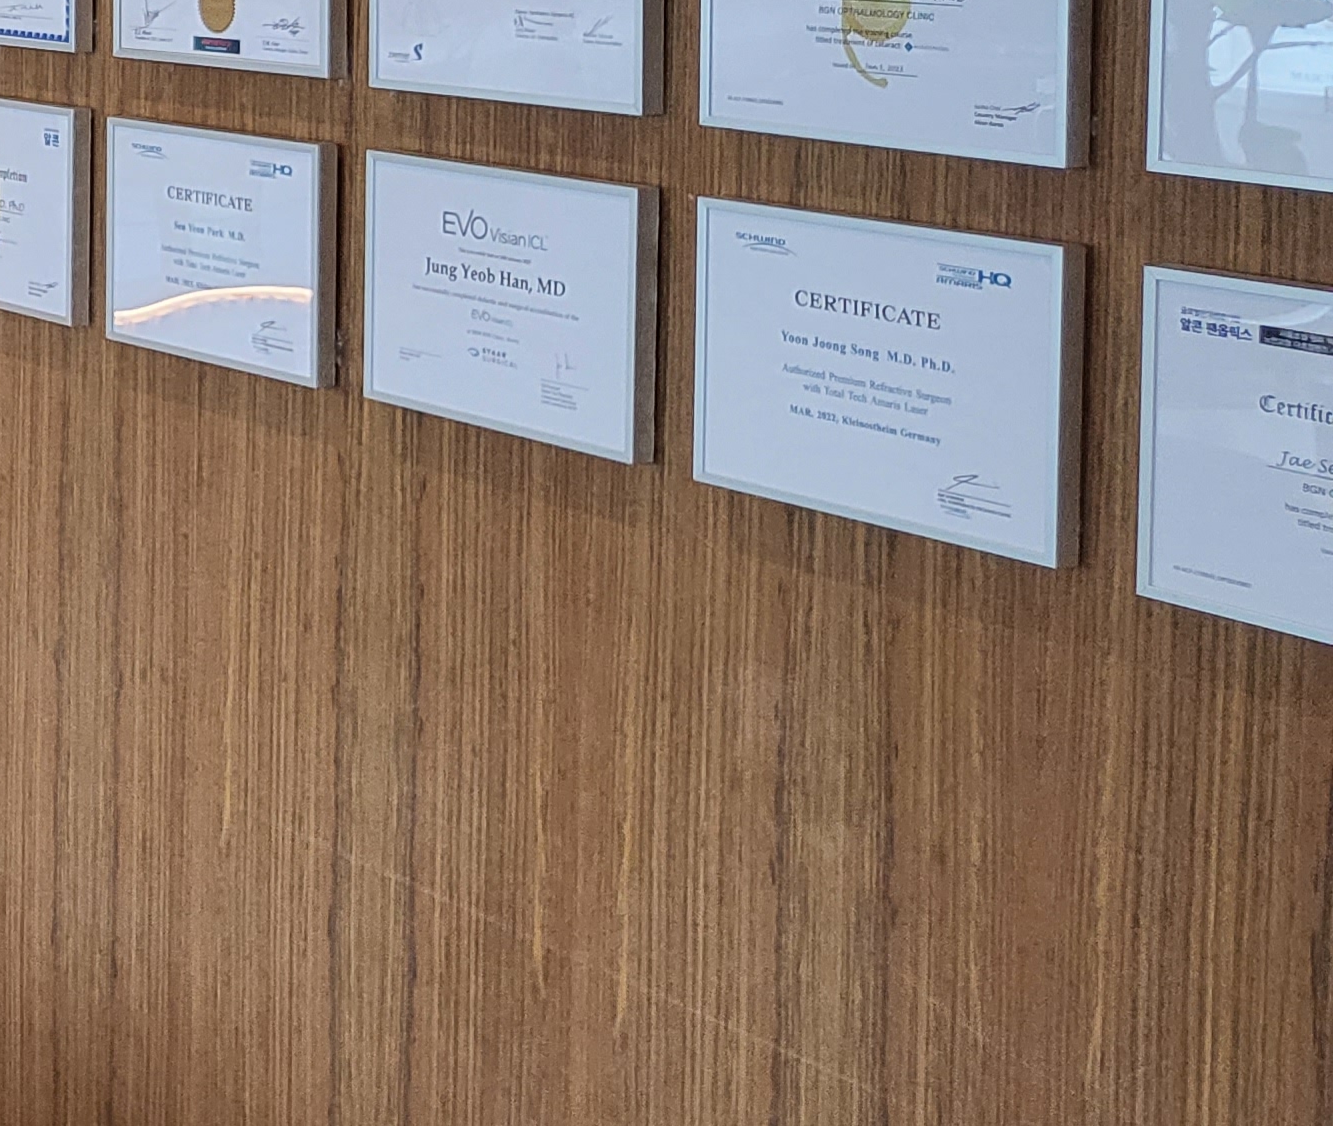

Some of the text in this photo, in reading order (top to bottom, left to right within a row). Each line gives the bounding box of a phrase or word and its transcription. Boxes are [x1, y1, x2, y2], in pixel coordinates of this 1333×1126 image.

[907, 11, 935, 21] CLINIC
[272, 163, 293, 177] HQ
[166, 185, 253, 213] CERTIFICATE
[441, 209, 488, 240] EVO
[490, 227, 526, 248] Visian
[425, 256, 566, 297] Jung Yeob Han, MD
[978, 269, 1011, 288] HQ
[794, 289, 941, 331] CERTIFICATE
[781, 329, 956, 374] Yoon Joong Song M.D. Ph.D.
[803, 382, 821, 394] with
[848, 391, 868, 404] Tech
[900, 428, 942, 447] Germany
[1275, 450, 1316, 470] Jae
[1302, 483, 1326, 496] BGN
